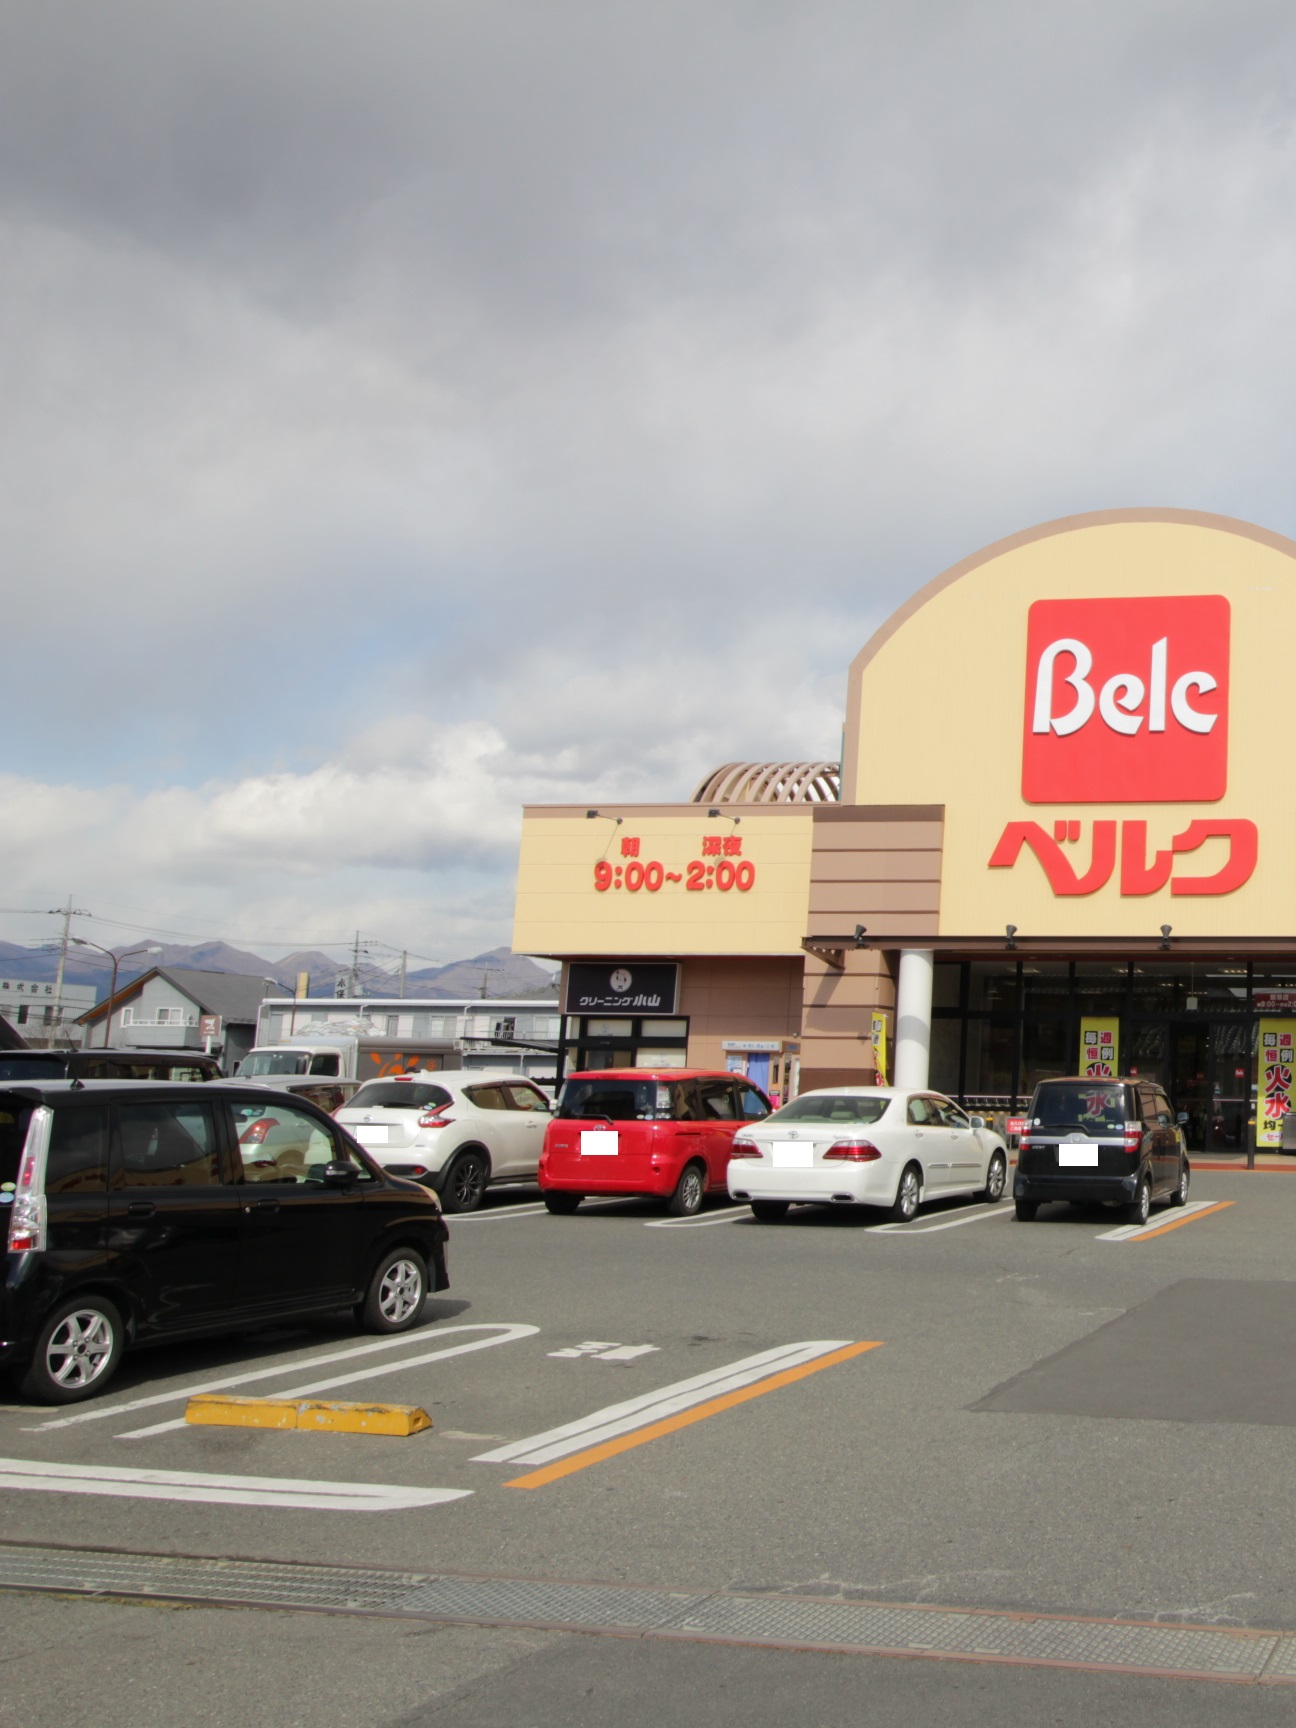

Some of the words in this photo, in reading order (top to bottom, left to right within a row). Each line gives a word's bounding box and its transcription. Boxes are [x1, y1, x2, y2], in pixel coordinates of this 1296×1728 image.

[1032, 636, 1219, 737] Belc
[620, 837, 641, 857] 朝
[702, 835, 742, 856] 深夜
[987, 818, 1259, 897] ベルク
[1084, 1031, 1113, 1045] 毎週
[1263, 1033, 1293, 1047] 毎週
[1086, 1047, 1114, 1060] 恒例
[1264, 1049, 1294, 1063] 恒例
